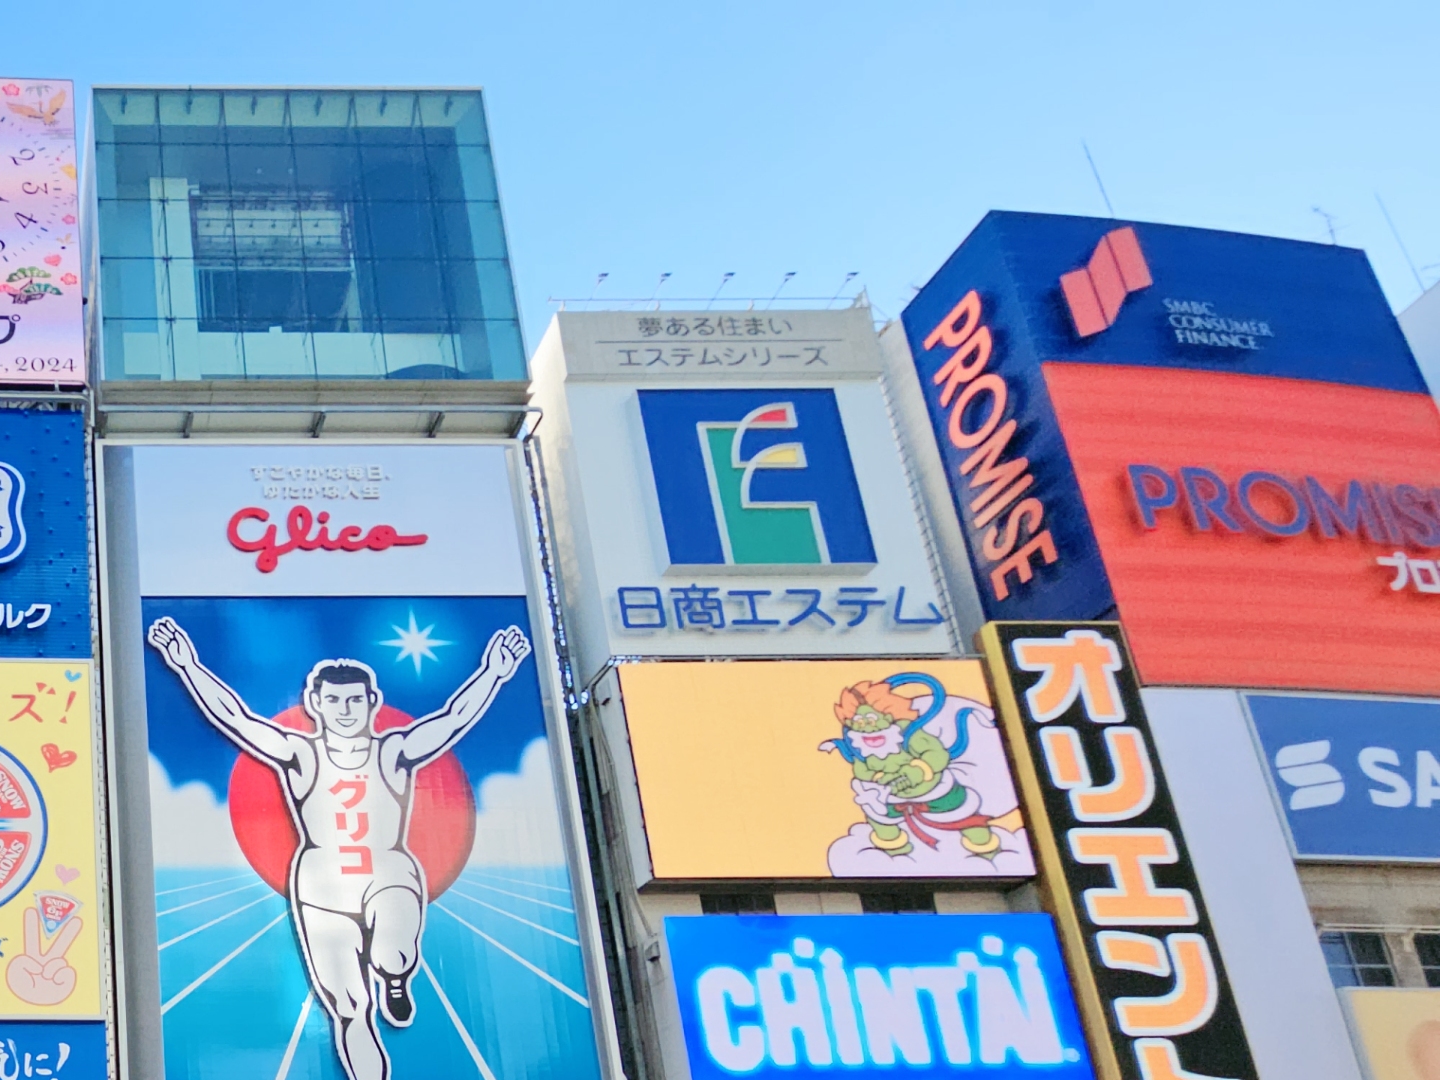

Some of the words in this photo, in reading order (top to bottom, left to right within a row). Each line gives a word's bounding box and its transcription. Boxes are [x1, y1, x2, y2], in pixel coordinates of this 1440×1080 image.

[10, 148, 35, 166] 2
[22, 182, 48, 196] 3
[14, 210, 38, 230] 4
[638, 317, 793, 337] 夢ある住まい
[1169, 314, 1275, 338] CONSUMER
[1174, 329, 1262, 350] FINANCE
[15, 356, 77, 373] 2024
[618, 347, 828, 367] エステムシリーズ
[923, 289, 1058, 602] PROMISE
[1127, 464, 1440, 548] PROMIS
[227, 505, 428, 574] Glico
[1377, 551, 1440, 593] プロ
[617, 583, 946, 630] 日商エステム
[327, 774, 374, 876] グリコ
